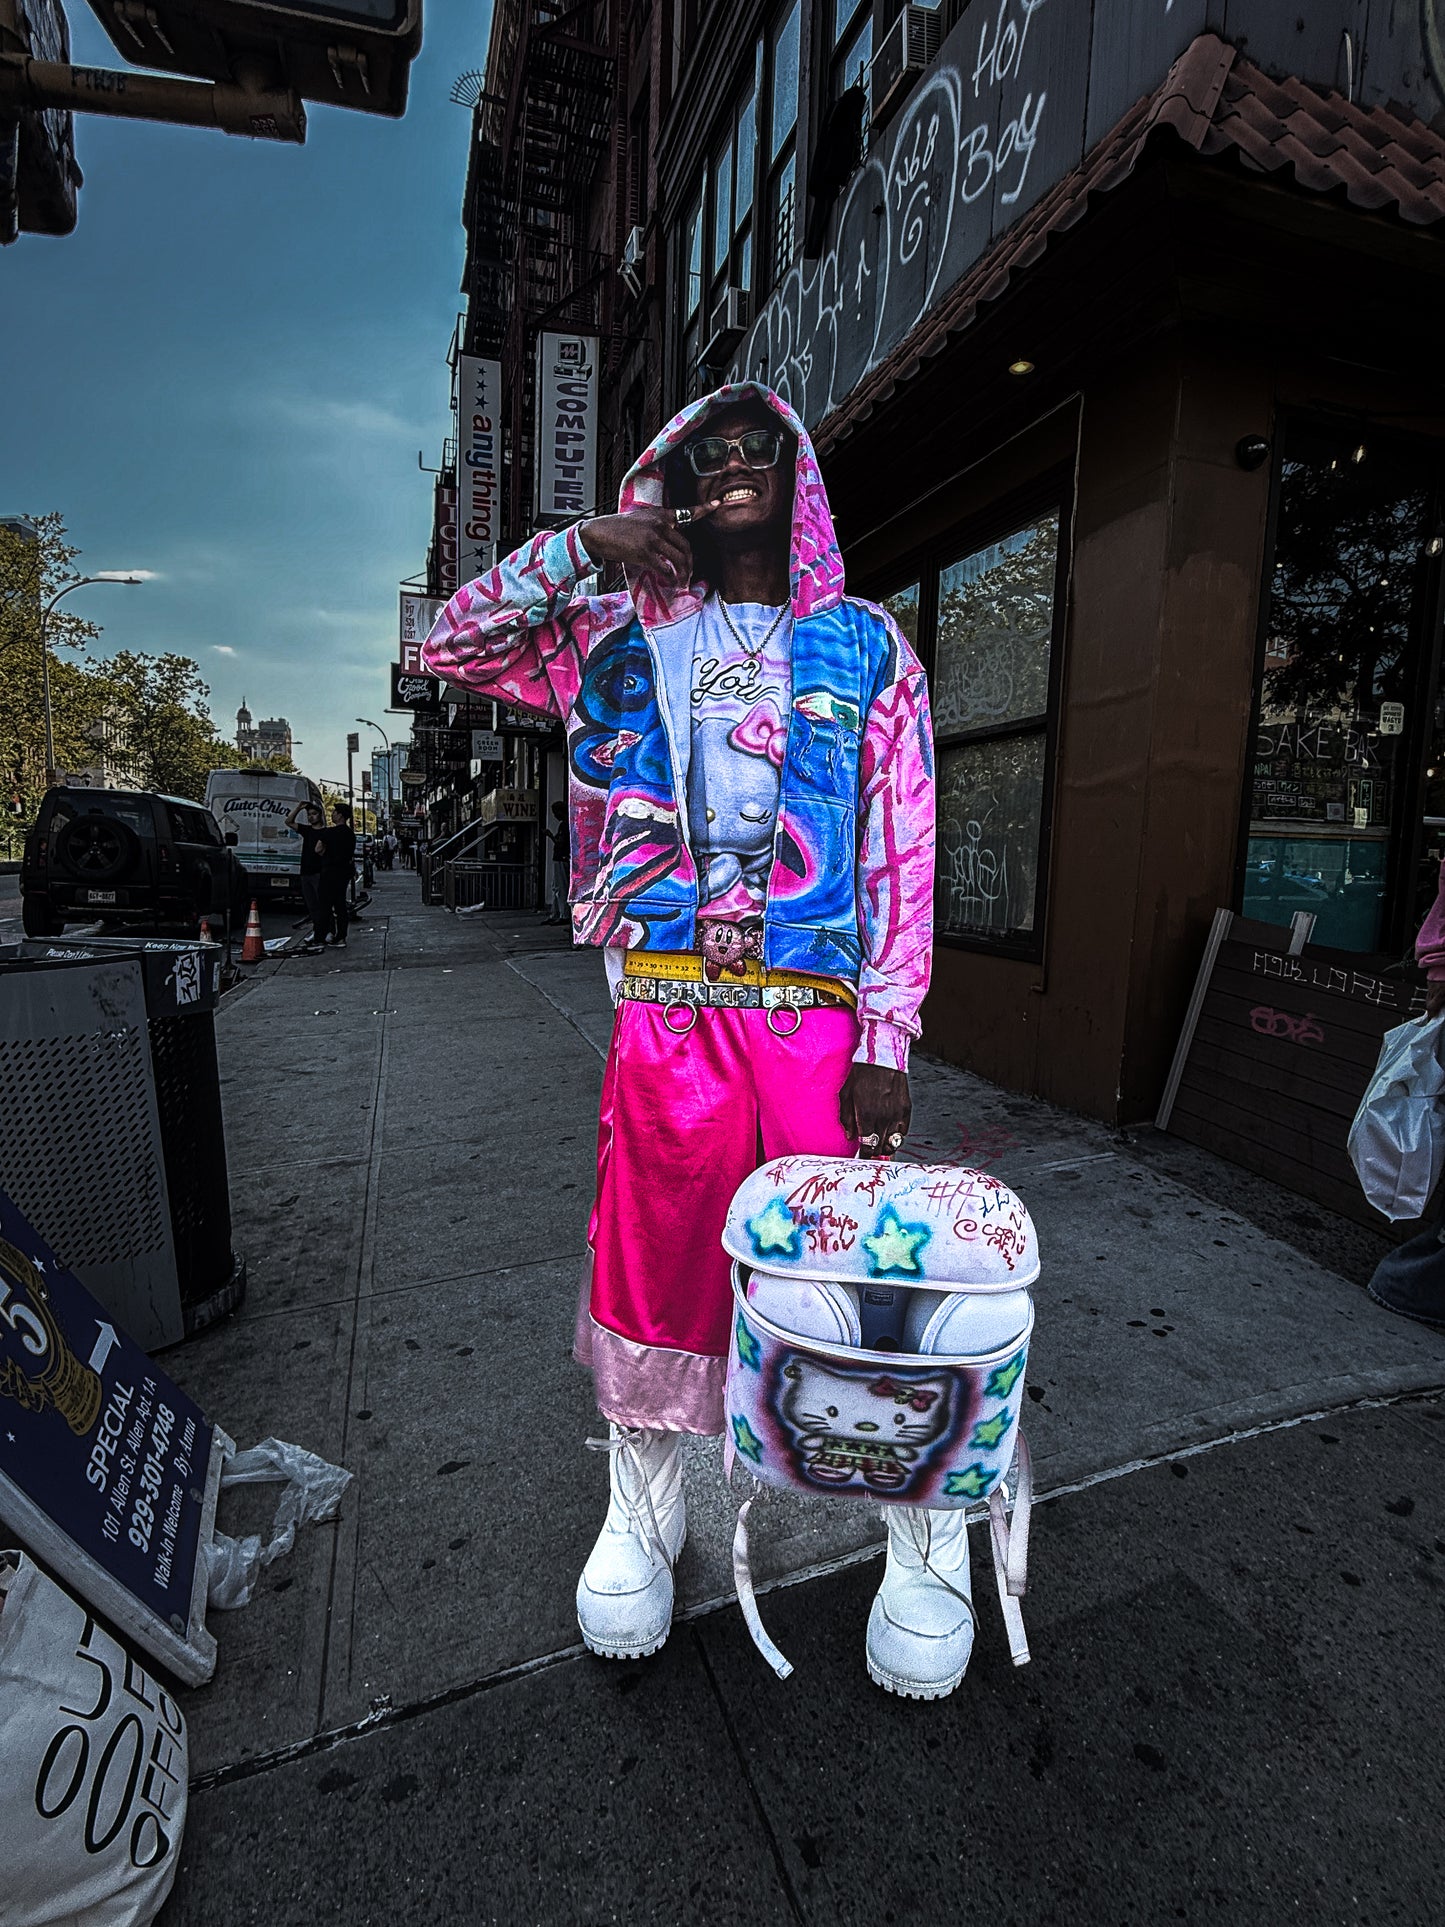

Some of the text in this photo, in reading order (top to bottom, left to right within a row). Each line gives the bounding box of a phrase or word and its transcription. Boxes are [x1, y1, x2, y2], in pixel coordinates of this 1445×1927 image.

[554, 382, 589, 512] COMPUTER
[465, 414, 497, 542] anything
[1343, 728, 1380, 763] BAR
[223, 798, 291, 817] Auto-Chlor
[504, 803, 537, 817] WINE
[144, 941, 169, 950] Keep
[142, 1376, 158, 1397] 1A
[86, 1380, 135, 1493] SPECIAL
[126, 1419, 146, 1456] Allen
[128, 1402, 176, 1554] 929-301-4748
[173, 1452, 193, 1478] By
[109, 1474, 132, 1516] Allen
[102, 1511, 121, 1543] 101
[153, 1483, 184, 1590] Walk-In Welcome
